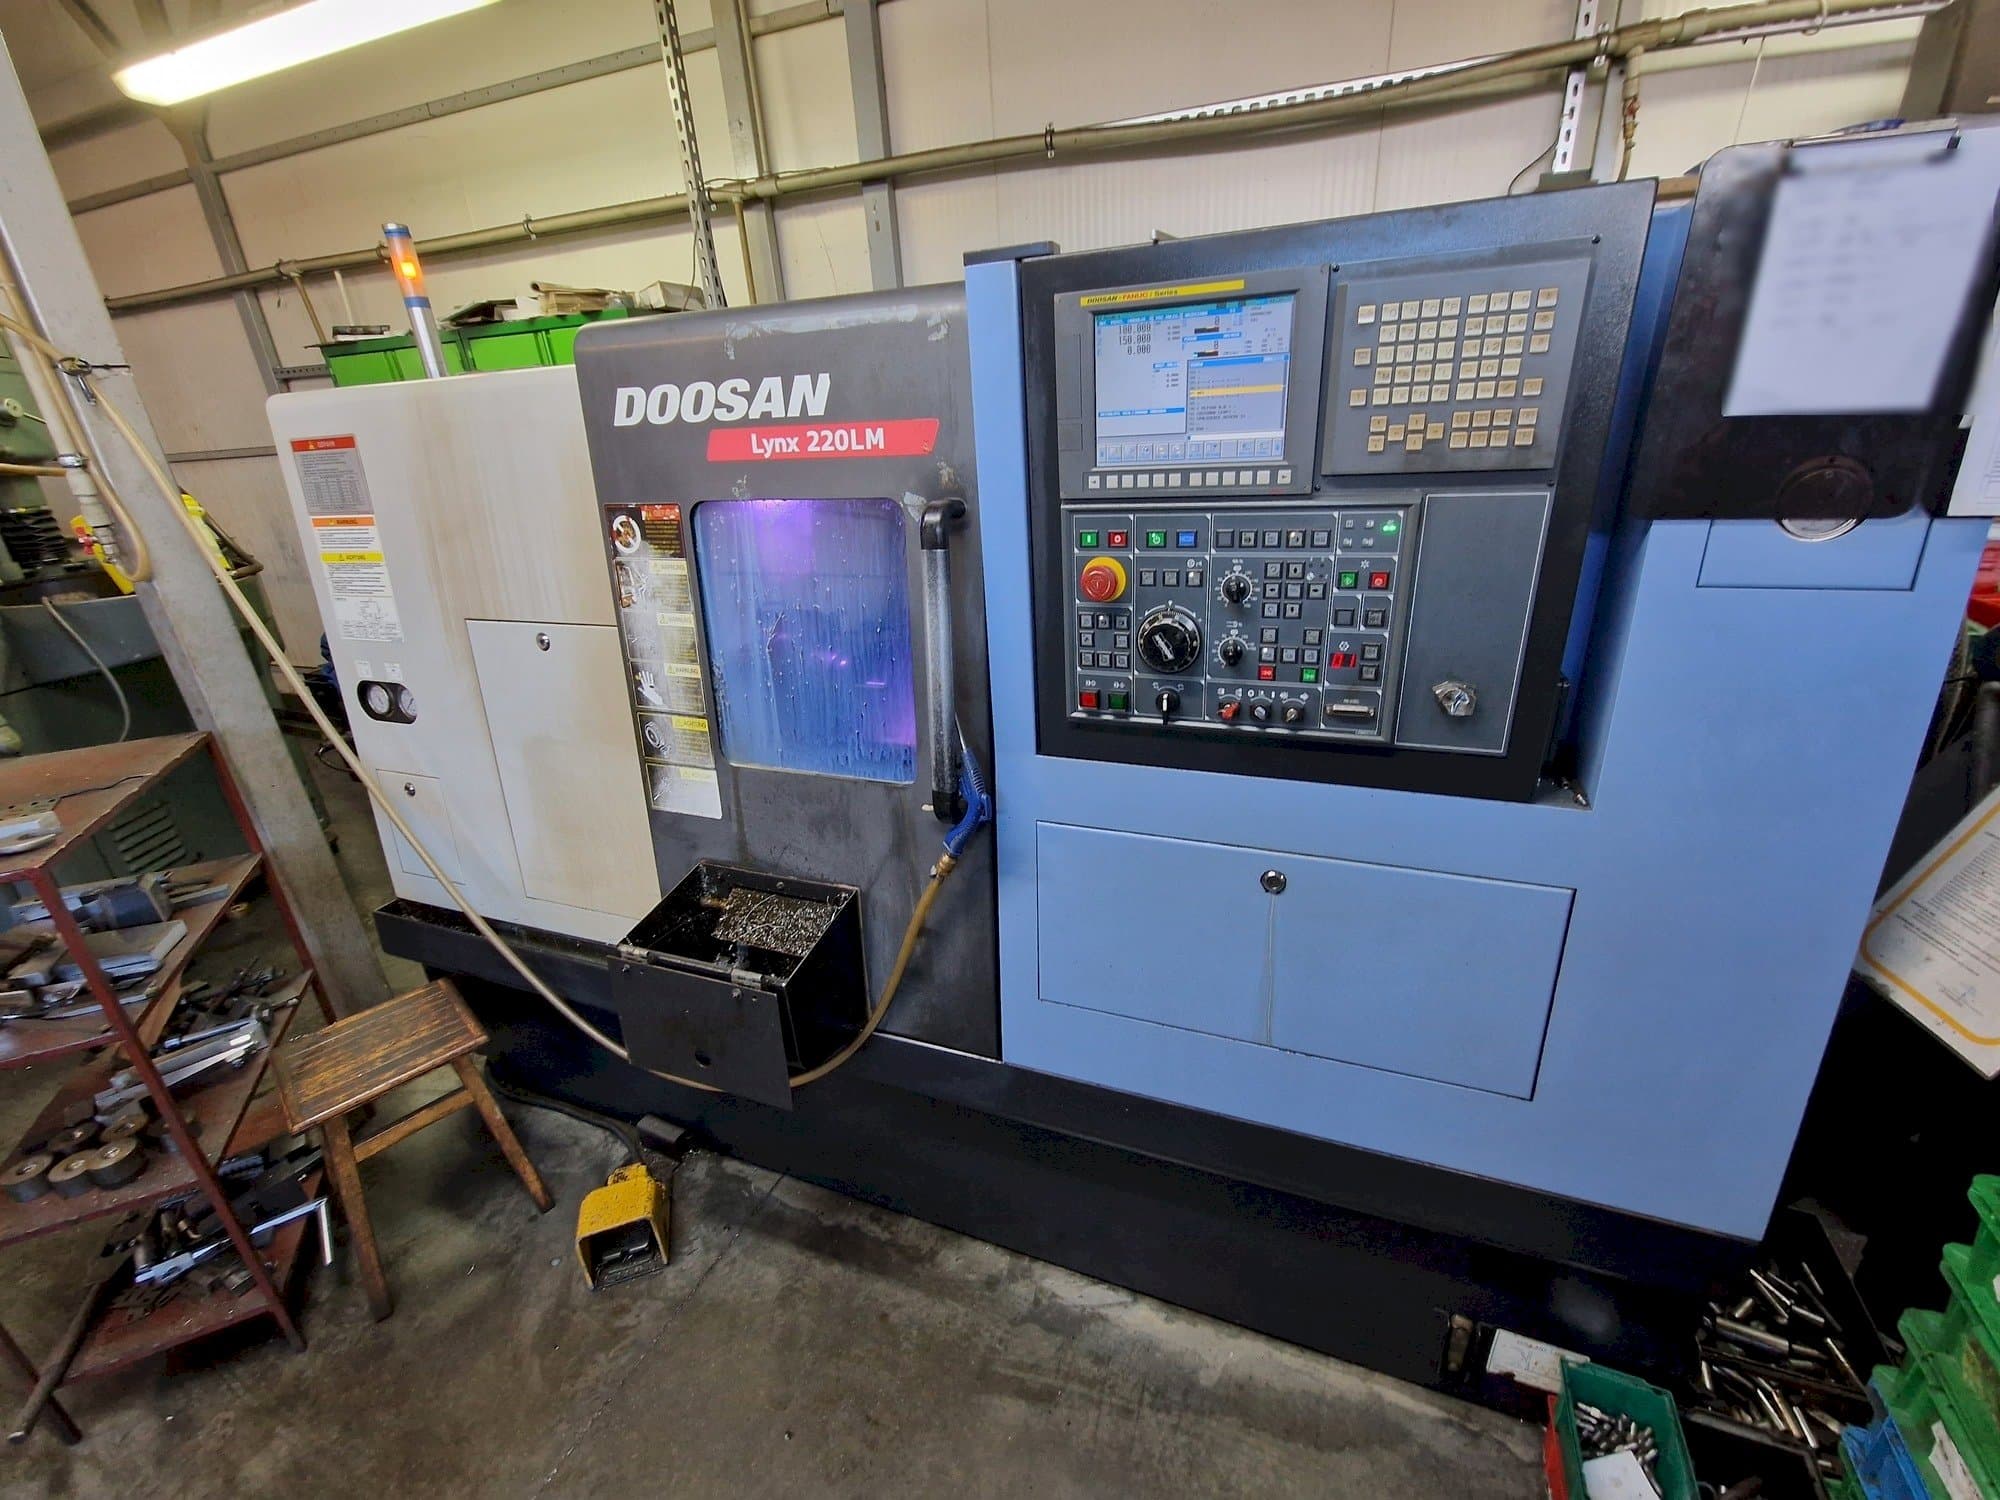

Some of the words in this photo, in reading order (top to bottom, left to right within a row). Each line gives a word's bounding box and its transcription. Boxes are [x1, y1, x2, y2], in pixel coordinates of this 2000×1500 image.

[614, 373, 831, 427] DOOSAN
[751, 432, 800, 458] Lynx
[806, 427, 885, 453] 220LM
